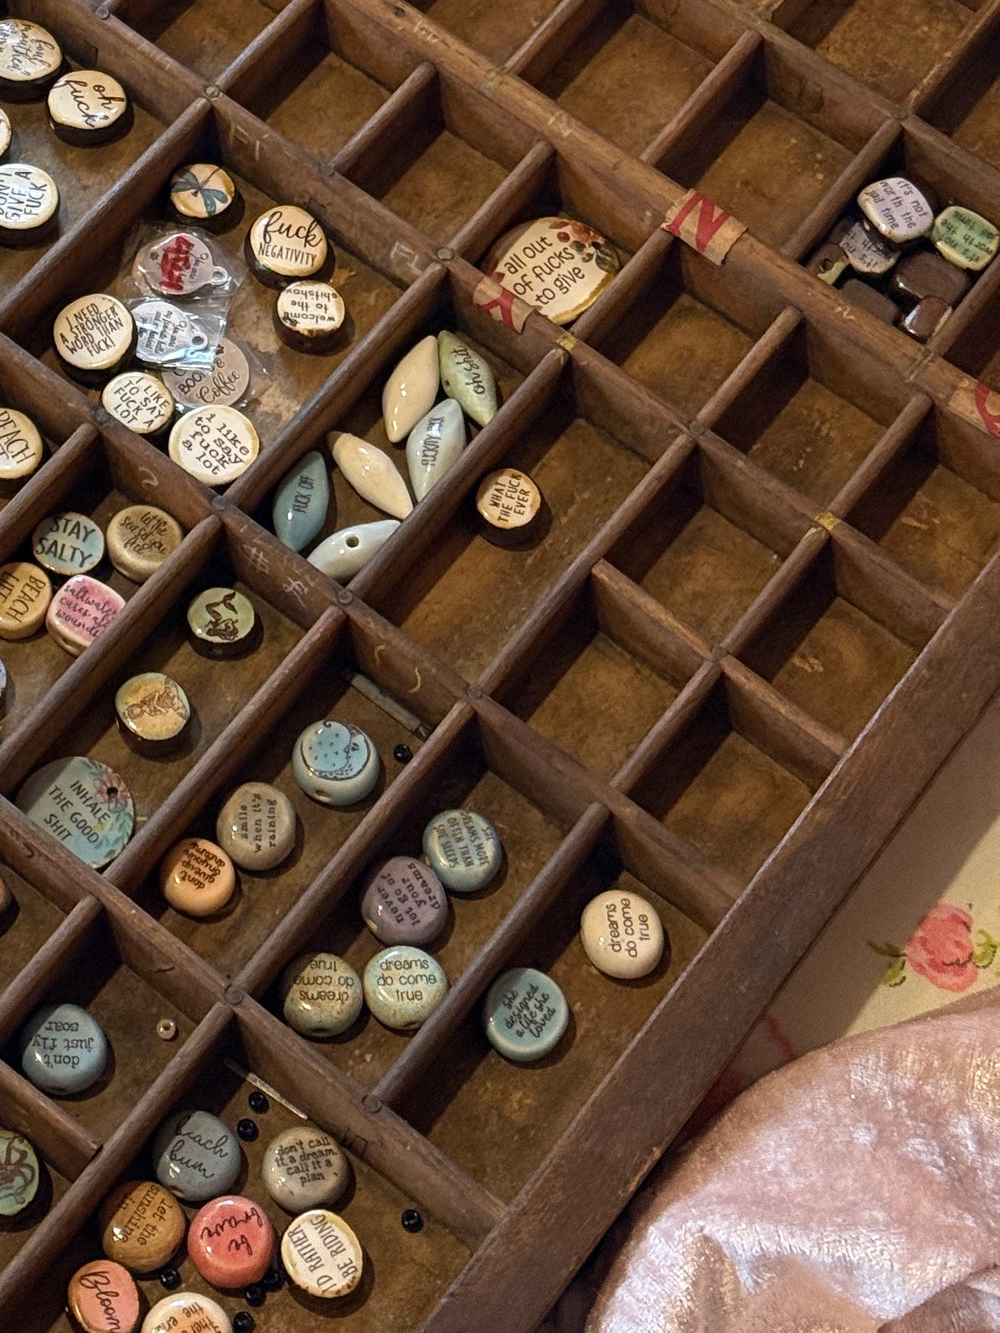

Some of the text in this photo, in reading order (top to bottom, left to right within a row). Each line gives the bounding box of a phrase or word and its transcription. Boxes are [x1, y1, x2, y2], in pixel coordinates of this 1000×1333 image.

[5, 171, 32, 220] GIVE A
[24, 183, 48, 216] FUCK
[880, 181, 917, 229] worth the
[898, 181, 928, 217] it's not
[263, 211, 322, 248] fuck
[881, 208, 899, 230] time
[258, 243, 318, 267] NEGATIVITY
[504, 237, 553, 275] all out
[513, 247, 575, 295] of fucks
[535, 267, 585, 305] to give
[65, 303, 100, 328] I NEED
[283, 310, 335, 324] welcome
[291, 300, 328, 313] to the
[61, 333, 68, 345] A
[72, 307, 119, 341] STRONGER
[65, 317, 123, 355] WORD THAN
[124, 380, 164, 420] TO SAY
[144, 385, 171, 409] LIKE
[196, 371, 242, 403] Coffee
[113, 402, 138, 424] LOT
[114, 386, 154, 428] FUCK A
[190, 431, 230, 470] fuck
[194, 417, 245, 466] to say
[205, 413, 251, 456] i like
[182, 440, 221, 476] a lot
[490, 481, 505, 508] WHAT
[498, 473, 522, 522] THE FUCK
[514, 489, 530, 516] EVER
[49, 516, 96, 543] STAY
[35, 538, 92, 568] SALTY
[48, 786, 100, 844] THE GOOD
[70, 780, 111, 824] INHALE
[43, 814, 73, 841] SHIT
[606, 903, 622, 953] dreams
[621, 898, 637, 958] do come
[639, 914, 650, 942] true
[377, 974, 437, 986] do come
[380, 958, 429, 969] dreams
[396, 990, 423, 1001] true
[288, 1224, 325, 1274] RATHER
[309, 1213, 359, 1280] BE RIDING
